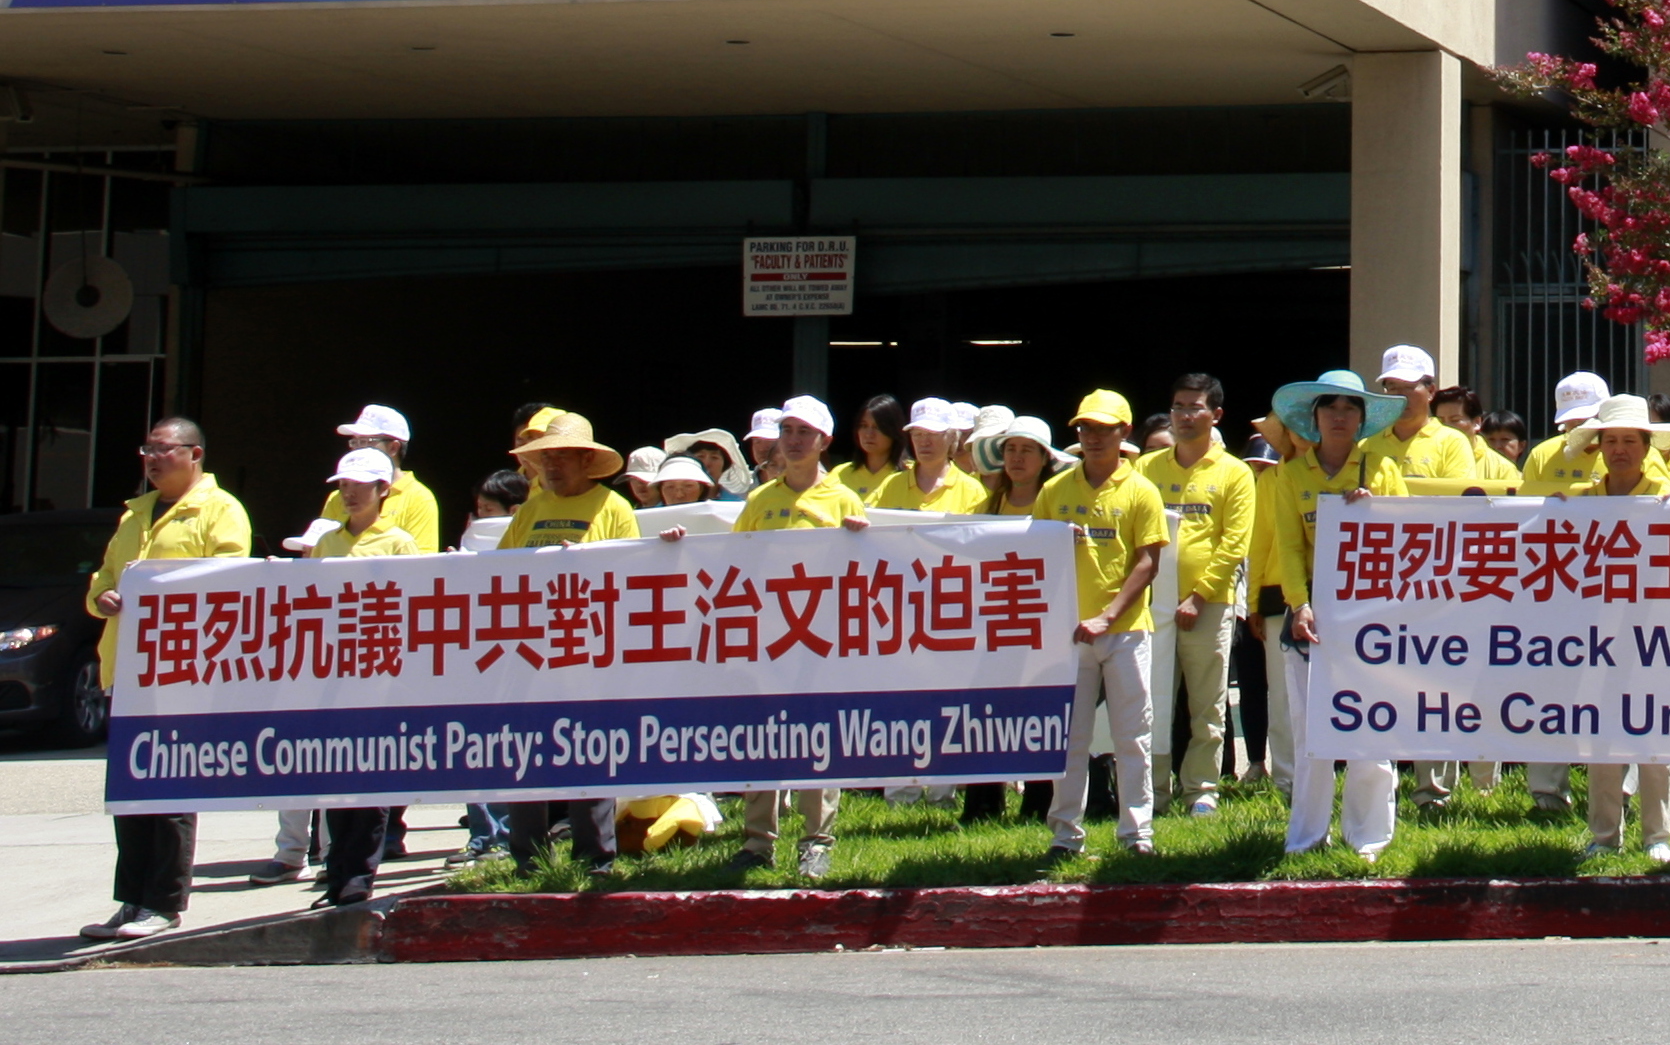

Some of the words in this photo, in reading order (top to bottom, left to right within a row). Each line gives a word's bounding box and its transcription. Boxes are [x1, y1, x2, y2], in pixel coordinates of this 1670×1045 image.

[750, 241, 793, 252] PARKING
[796, 241, 815, 252] FOR
[818, 240, 849, 252] D.R.U.
[794, 254, 801, 269] &
[137, 552, 1048, 688] 强烈抗議中共對王治文的迫害
[1355, 623, 1469, 666] Give
[1489, 624, 1615, 667] Back
[1330, 690, 1398, 733] So
[1417, 691, 1482, 733] He
[1500, 692, 1599, 735] Can
[130, 729, 248, 781] Chinese
[255, 721, 437, 775] Communist
[446, 721, 544, 782] Party:
[553, 717, 630, 777] Stop
[640, 710, 831, 772] Persecuting
[838, 707, 932, 768] Wang
[940, 702, 1071, 755] Zhiwen!
